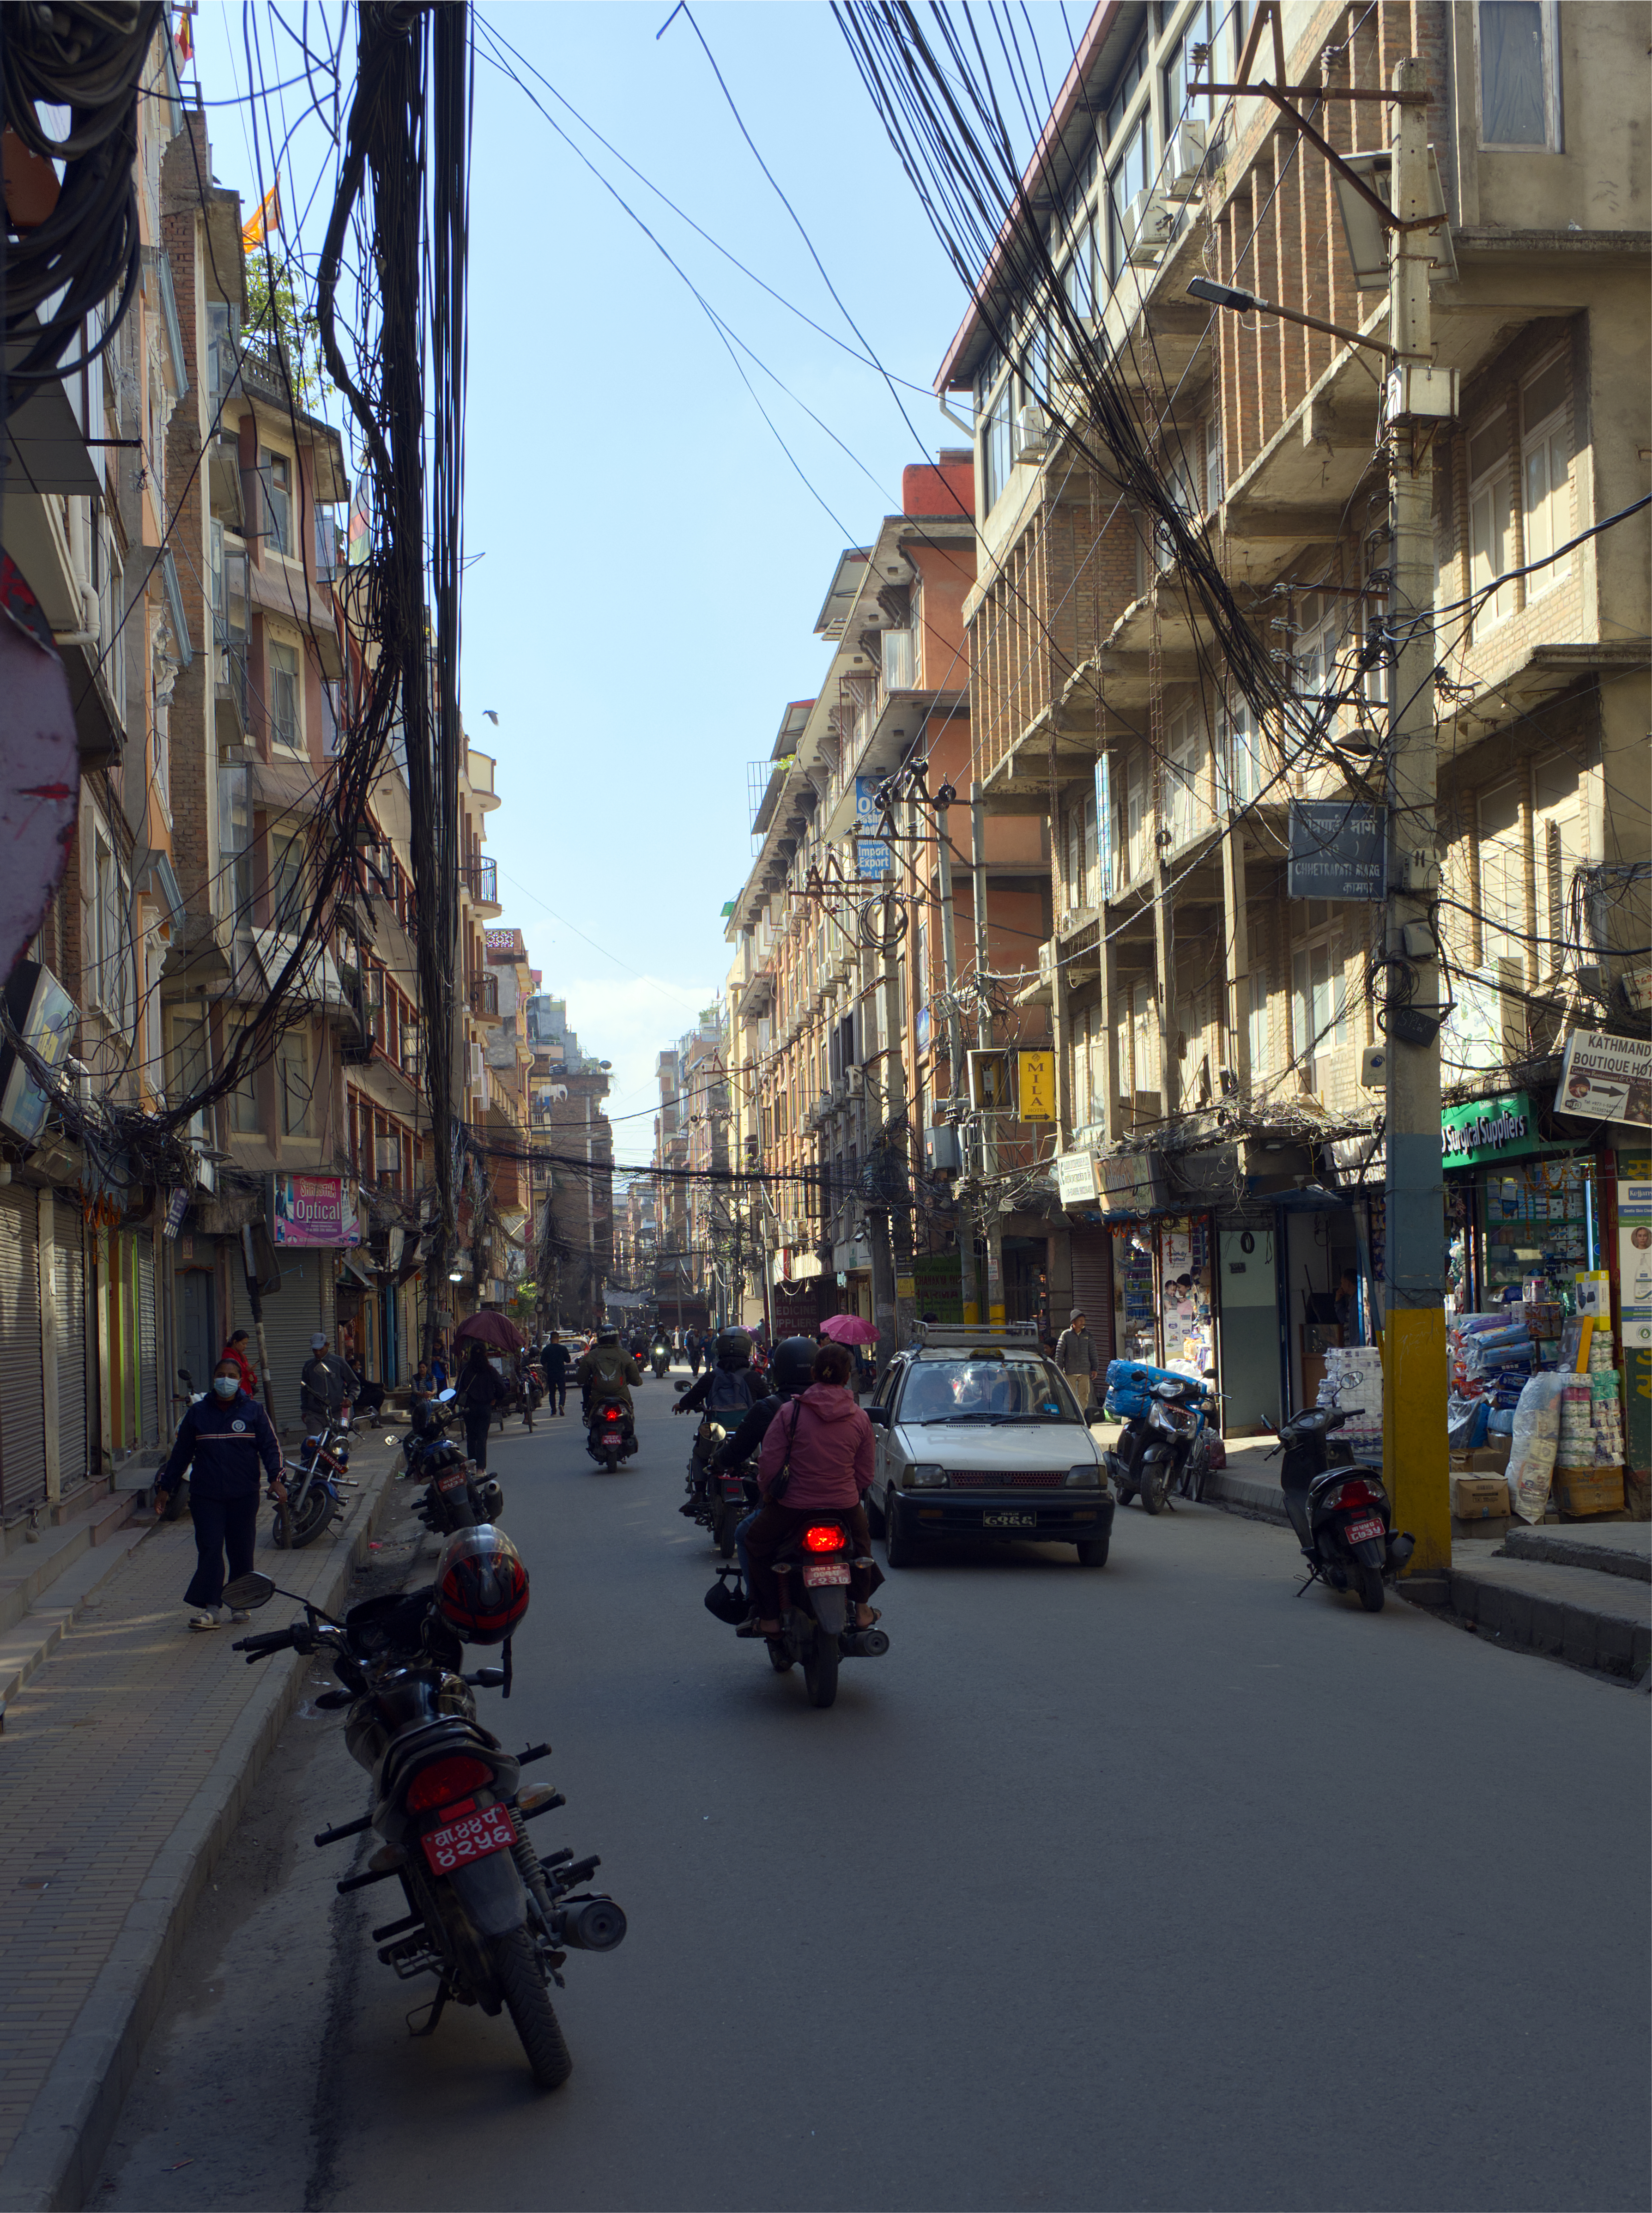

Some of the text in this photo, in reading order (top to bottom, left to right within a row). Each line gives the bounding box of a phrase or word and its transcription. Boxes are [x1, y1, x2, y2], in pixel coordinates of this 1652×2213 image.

[859, 846, 889, 858] Import
[859, 858, 889, 870] Export
[1295, 862, 1380, 877] CHHETRAPATI MARG
[1588, 1035, 1652, 1057] KATHMAND
[1573, 1052, 1630, 1073] BOUTIQUE
[1572, 1067, 1591, 1076] Garden
[1591, 1071, 1619, 1081] Restaurant
[1027, 1063, 1044, 1106] MILA
[1446, 1116, 1481, 1155] Surgical
[1479, 1110, 1525, 1150] Suppliers
[301, 1179, 336, 1198] SHRESTHA
[297, 1200, 340, 1224] Optical
[776, 1293, 817, 1303] PRAMILA
[776, 1305, 817, 1316] EDICINE
[436, 1825, 512, 1867] ४२५६
